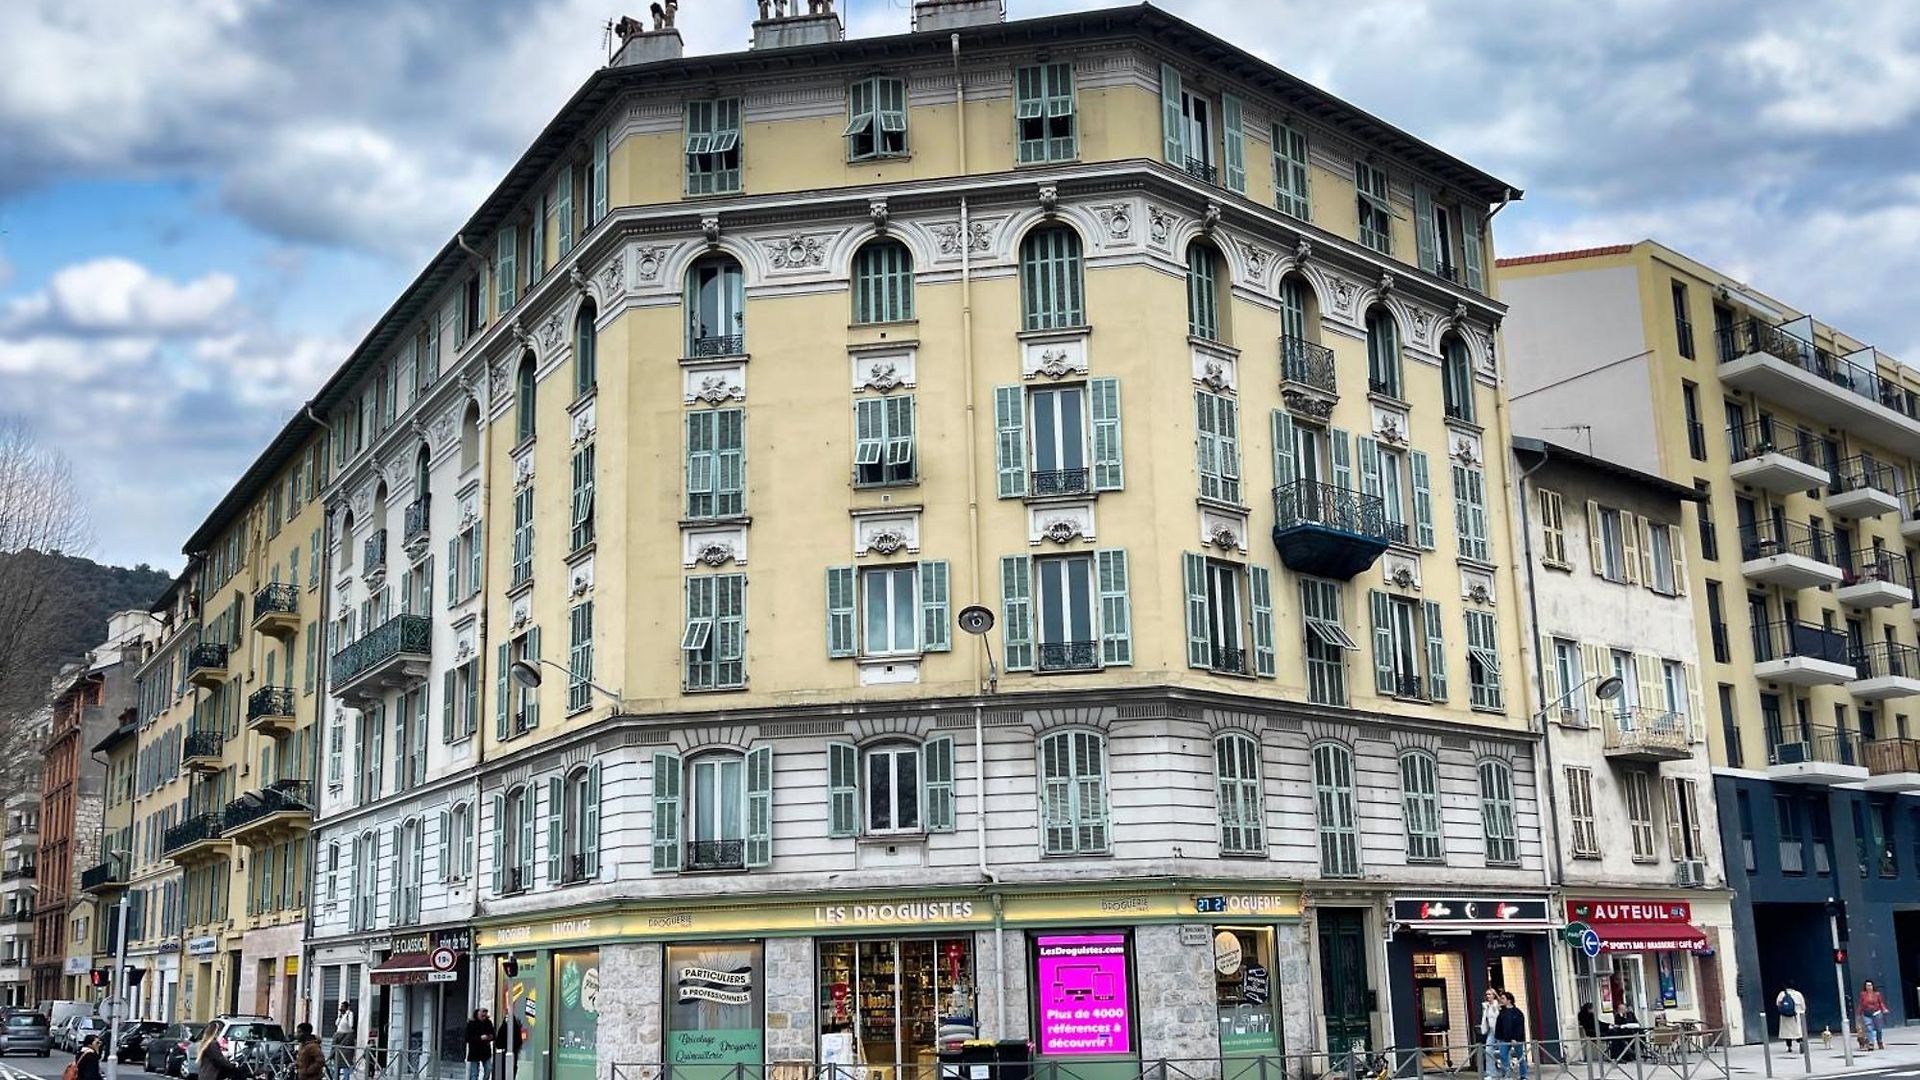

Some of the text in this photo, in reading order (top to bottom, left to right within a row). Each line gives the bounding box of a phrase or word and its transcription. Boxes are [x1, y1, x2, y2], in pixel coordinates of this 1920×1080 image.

[1227, 896, 1281, 912] OGUERIE
[815, 901, 973, 923] LES DROGUISTES
[1595, 905, 1669, 919] AUTEUIL
[648, 914, 693, 927] DROGUERIE
[1040, 946, 1124, 957] LesDroguistes.com
[685, 969, 746, 983] PARTICULIERS
[689, 989, 748, 1002] PROFESSIONNELS
[1047, 1008, 1124, 1020] Plus de 4000
[1047, 1022, 1122, 1034] références à
[1048, 1037, 1107, 1049] découvrir
